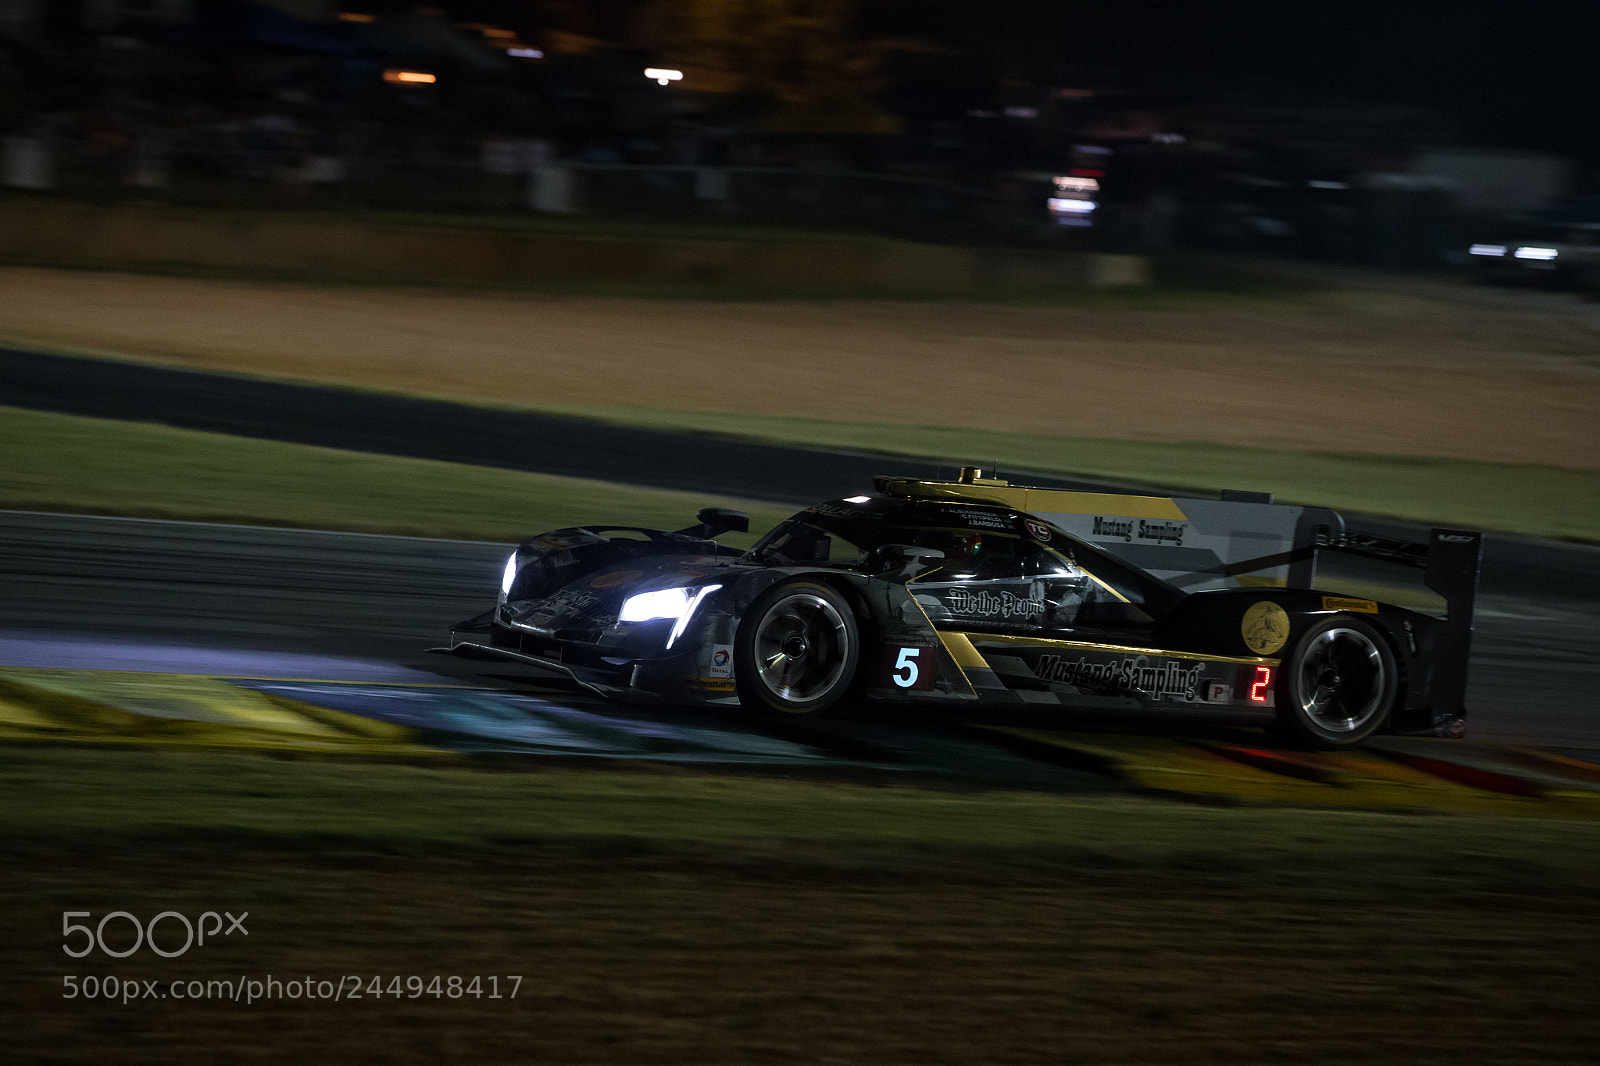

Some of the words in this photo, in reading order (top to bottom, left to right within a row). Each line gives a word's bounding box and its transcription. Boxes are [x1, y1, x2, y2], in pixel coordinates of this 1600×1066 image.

[1027, 522, 1049, 536] TC
[1092, 515, 1134, 543] Mustang
[1138, 519, 1187, 546] Sampling
[949, 587, 977, 614] We
[978, 590, 1000, 616] the
[892, 647, 920, 688] 5
[1035, 654, 1117, 690] Mustang
[1119, 658, 1199, 702] Sampling
[1213, 686, 1224, 699] P
[1251, 666, 1271, 702] 2
